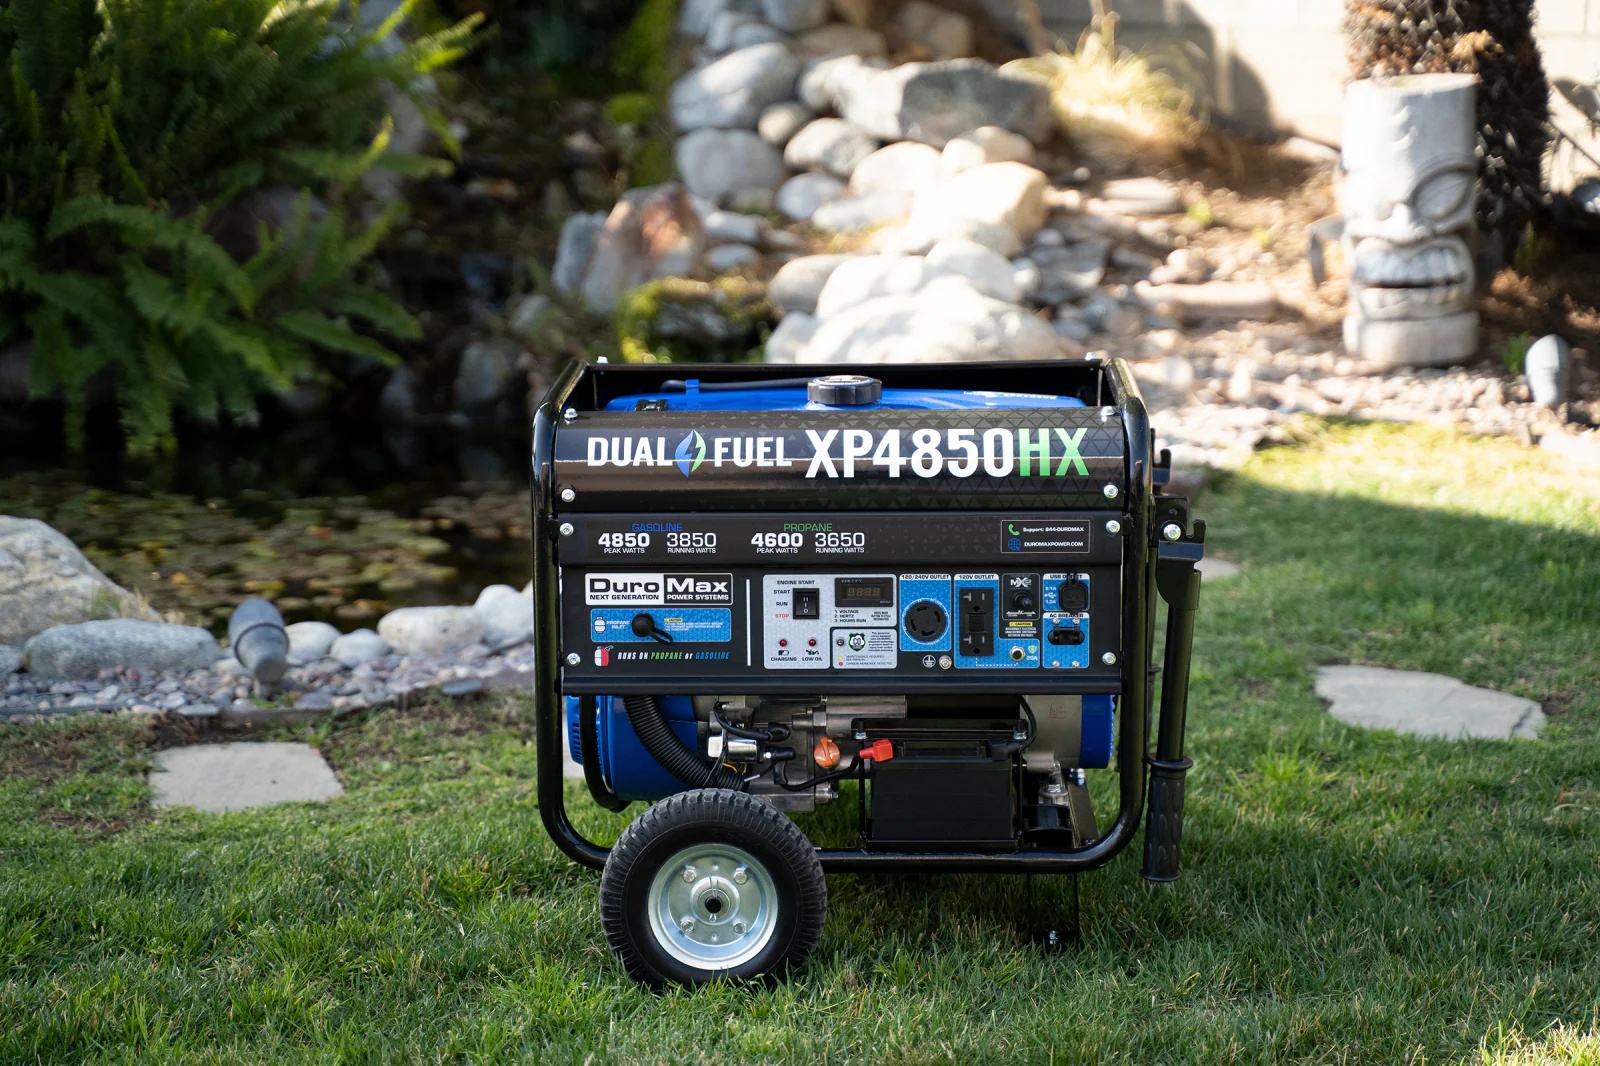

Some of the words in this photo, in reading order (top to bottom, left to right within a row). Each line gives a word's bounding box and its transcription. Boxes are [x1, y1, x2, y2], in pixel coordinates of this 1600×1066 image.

[587, 437, 673, 467] DUAL
[714, 437, 792, 467] FUEL
[805, 428, 1090, 478] XP4850HX
[631, 523, 683, 532] GASOLINE
[783, 523, 833, 532] PROPANE
[598, 532, 650, 547] 4850
[666, 532, 717, 547] 3850
[750, 532, 804, 547] 4600
[814, 532, 865, 547] 3650
[589, 578, 660, 593] Duro
[666, 578, 728, 593] Max
[617, 652, 636, 660] RUNS
[638, 652, 649, 660] ON
[650, 652, 683, 660] PROPANE
[695, 652, 730, 660] GASOLINE
